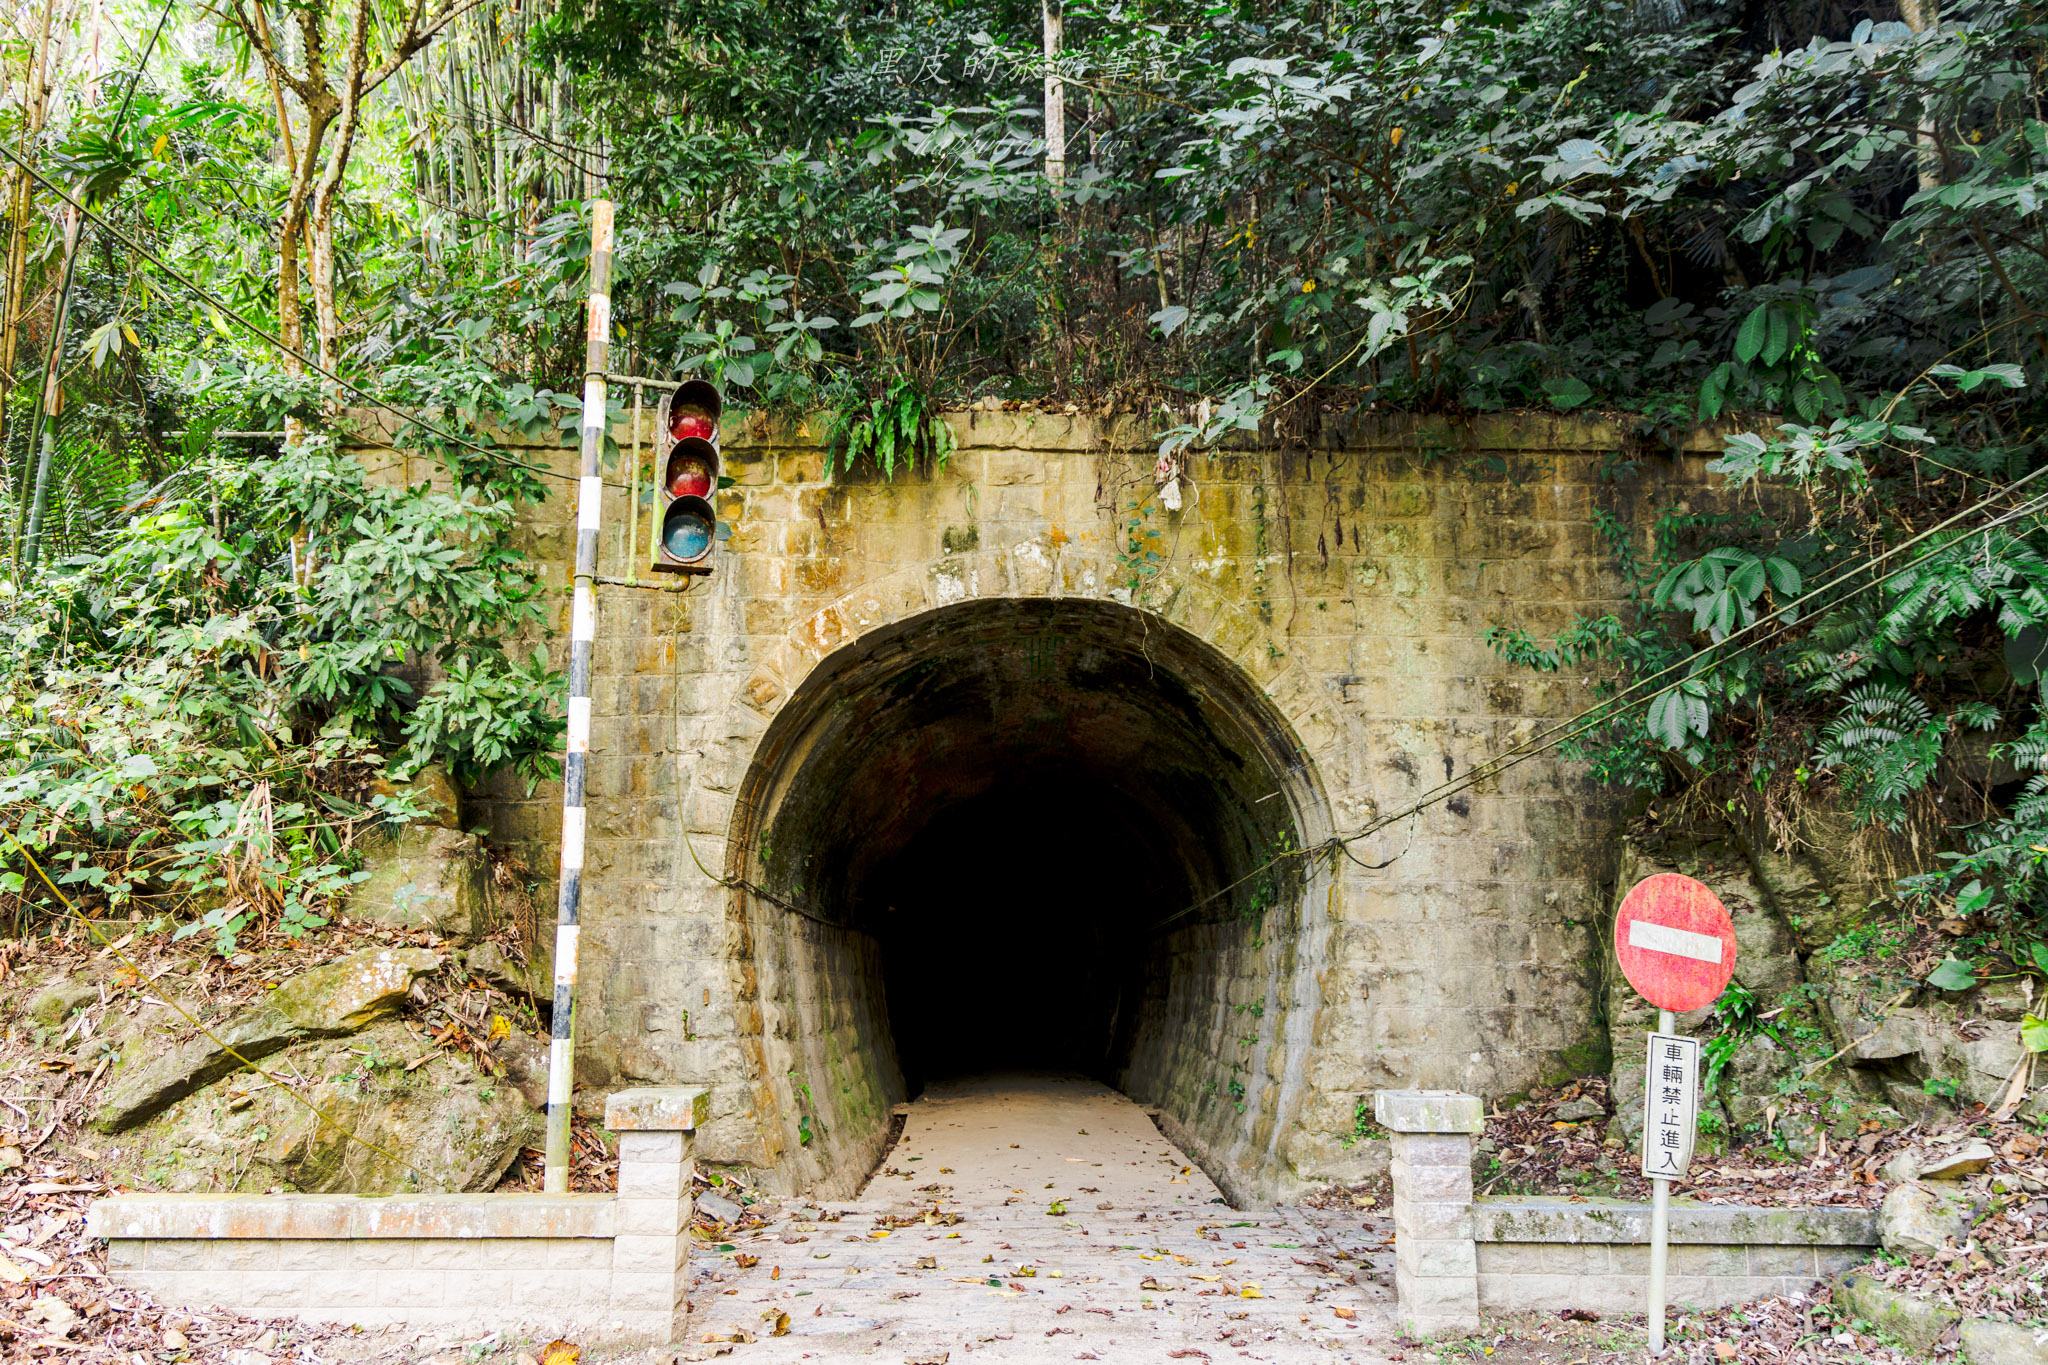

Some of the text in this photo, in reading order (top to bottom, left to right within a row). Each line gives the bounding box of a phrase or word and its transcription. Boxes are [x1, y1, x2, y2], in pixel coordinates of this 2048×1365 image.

[1660, 1043, 1683, 1170] 車輛禁止進入
